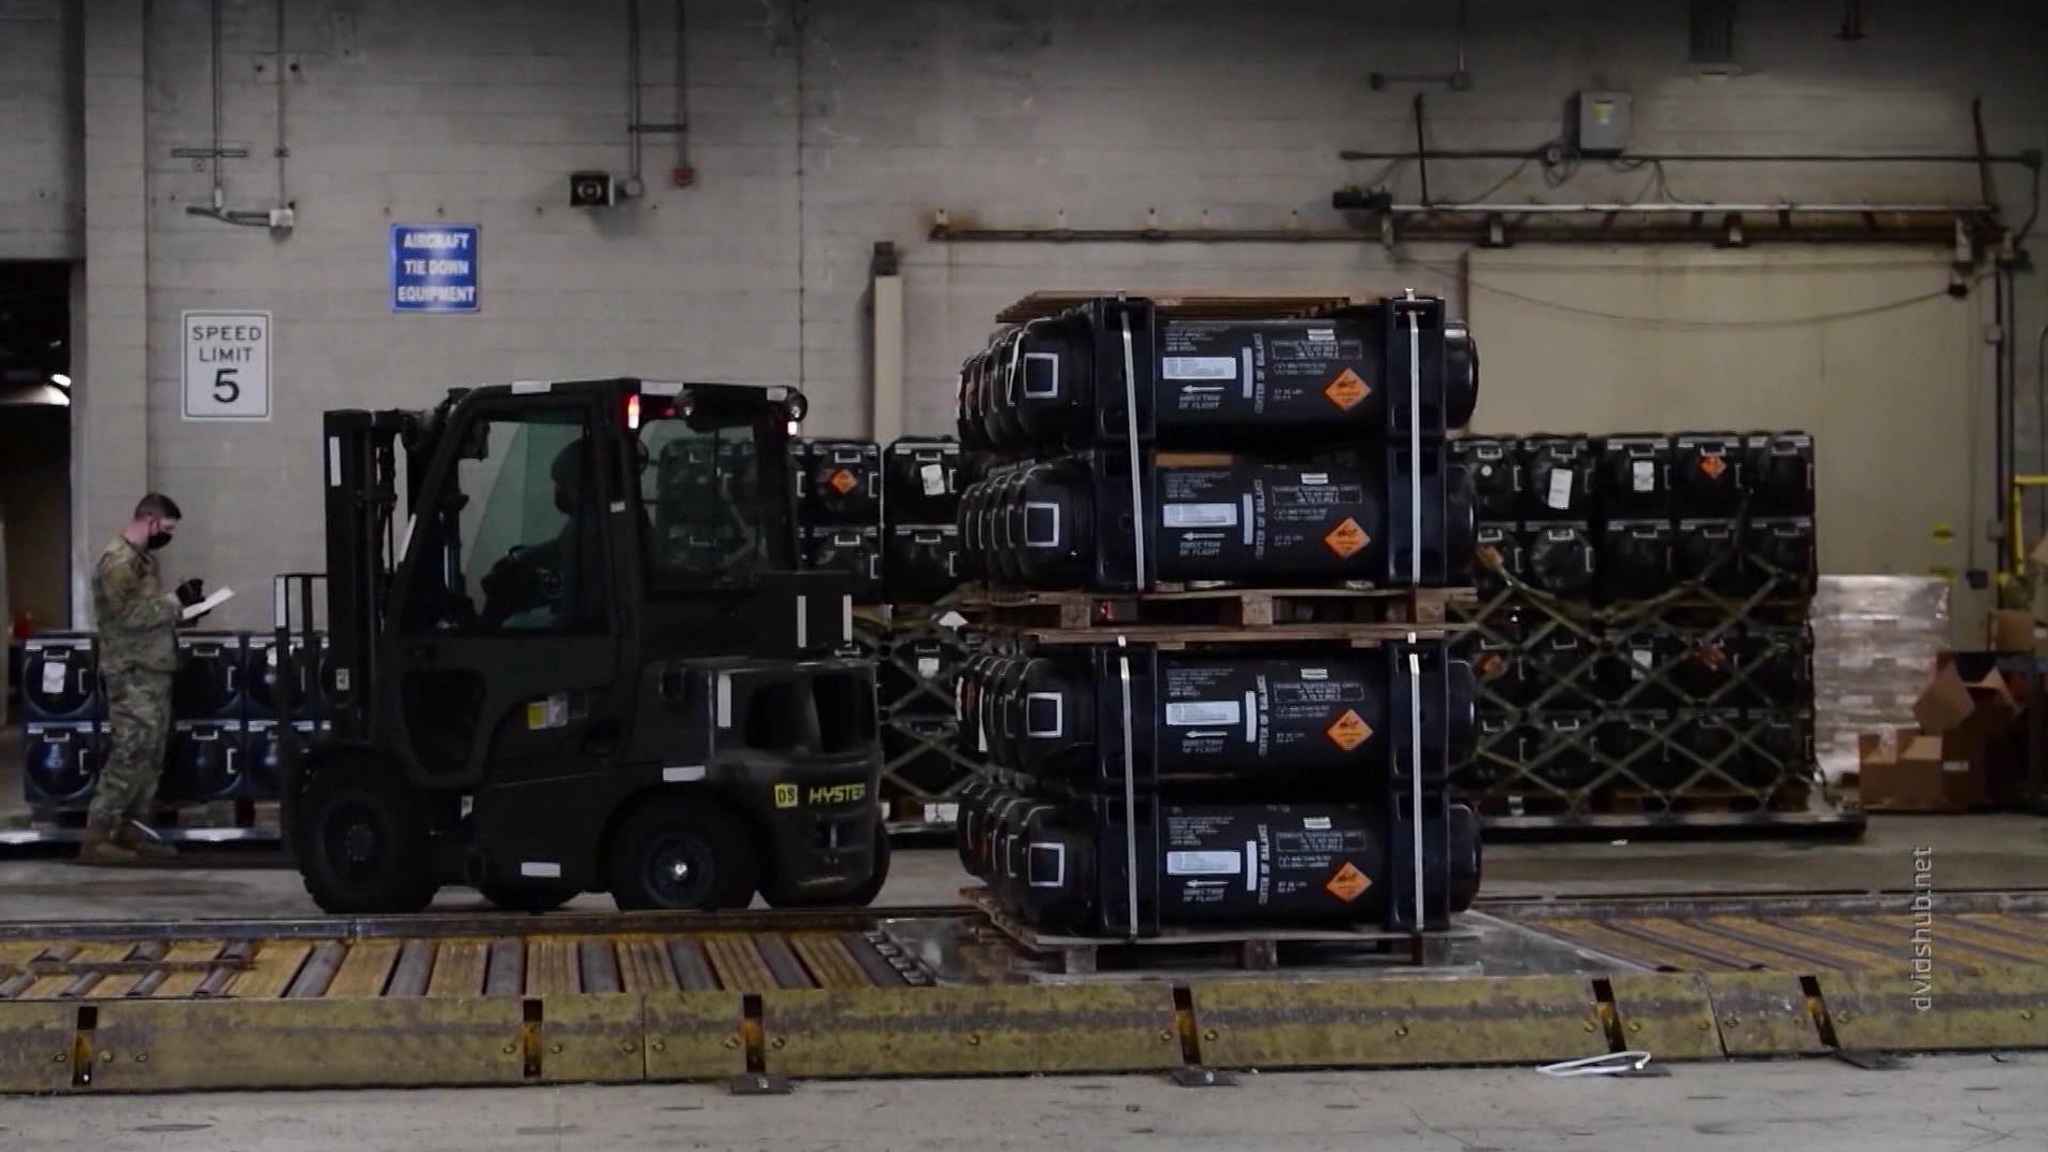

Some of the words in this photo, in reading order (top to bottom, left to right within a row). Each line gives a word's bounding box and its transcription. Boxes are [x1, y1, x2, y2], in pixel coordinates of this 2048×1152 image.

[404, 232, 470, 249] AIRCRAFT
[404, 260, 427, 275] TIE
[428, 260, 469, 275] DOWN
[398, 286, 475, 302] EQUIPMENT
[192, 325, 262, 341] SPEED
[199, 346, 252, 362] LIMIT
[213, 368, 240, 403] 5
